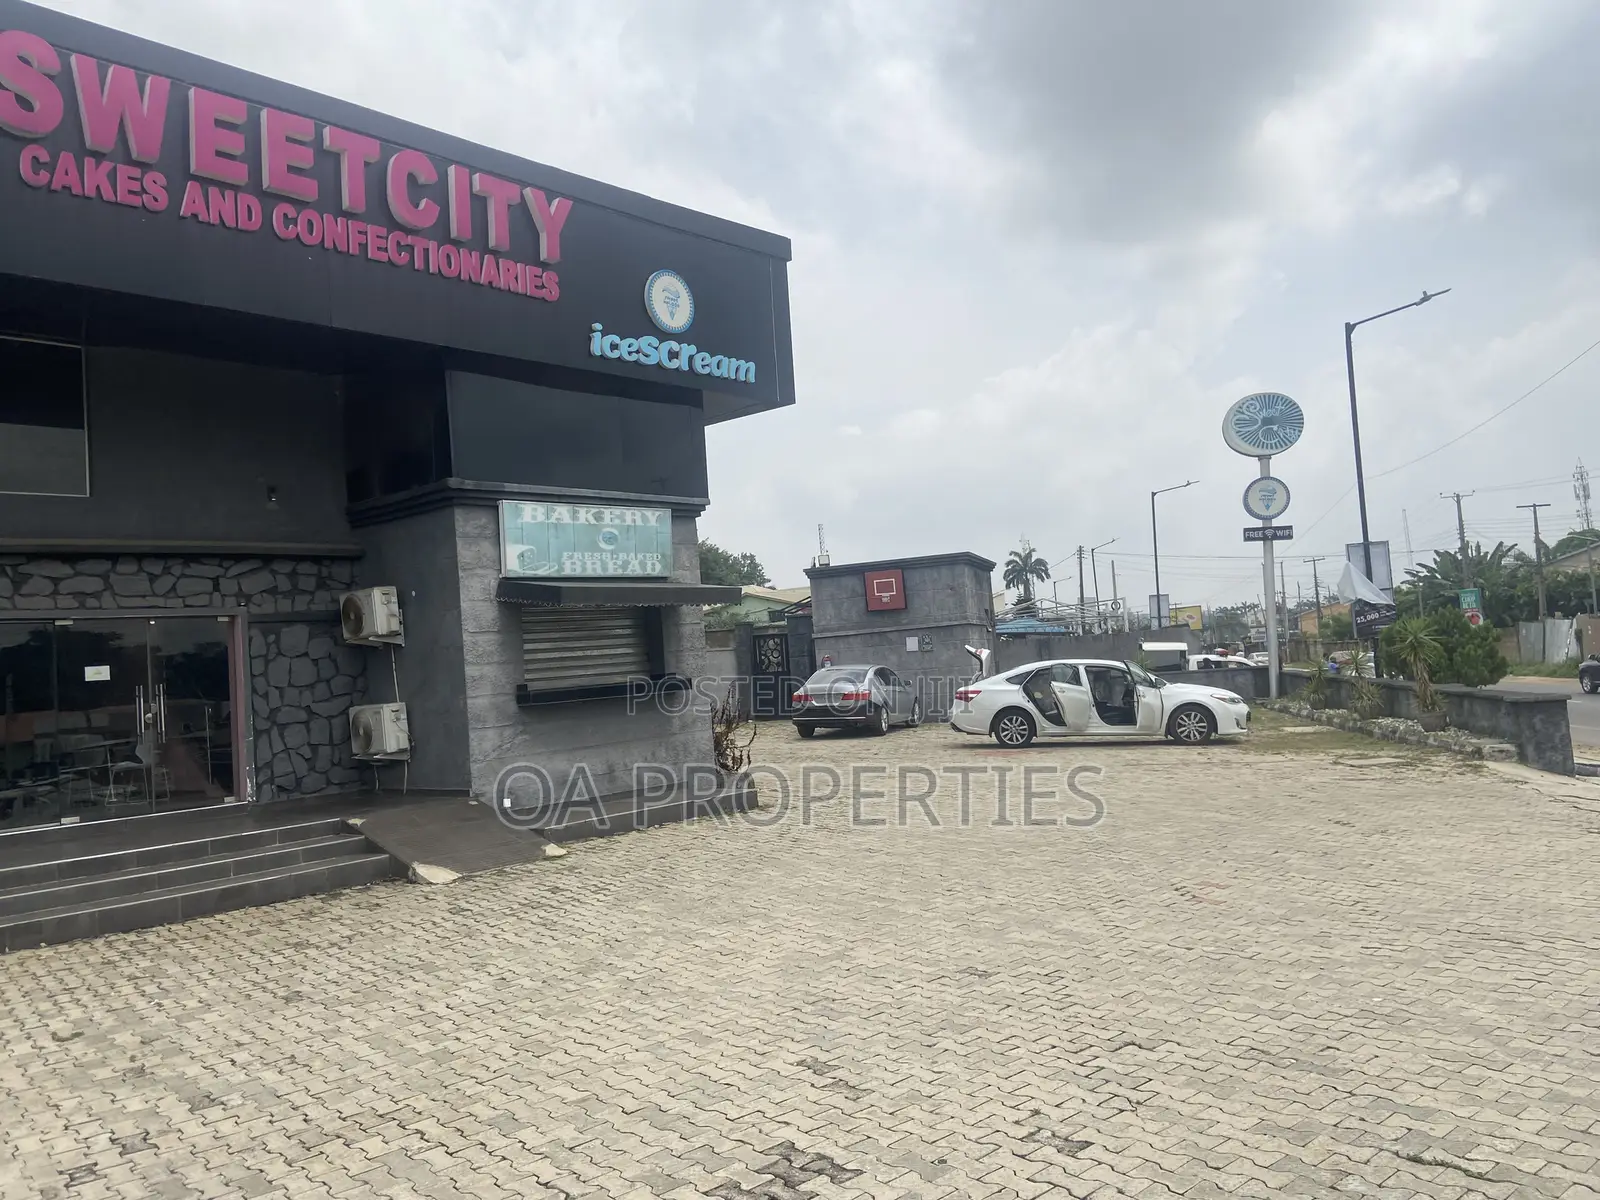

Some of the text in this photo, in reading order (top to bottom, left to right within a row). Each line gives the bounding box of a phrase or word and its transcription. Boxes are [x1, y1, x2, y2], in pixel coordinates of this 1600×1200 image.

[19, 144, 560, 302] CAKES AND CONFECTIONARIES
[517, 503, 664, 526] BAKERY
[1245, 529, 1293, 538] FREE WIFI
[560, 559, 662, 576] BREAD
[1355, 612, 1380, 624] 25,000
